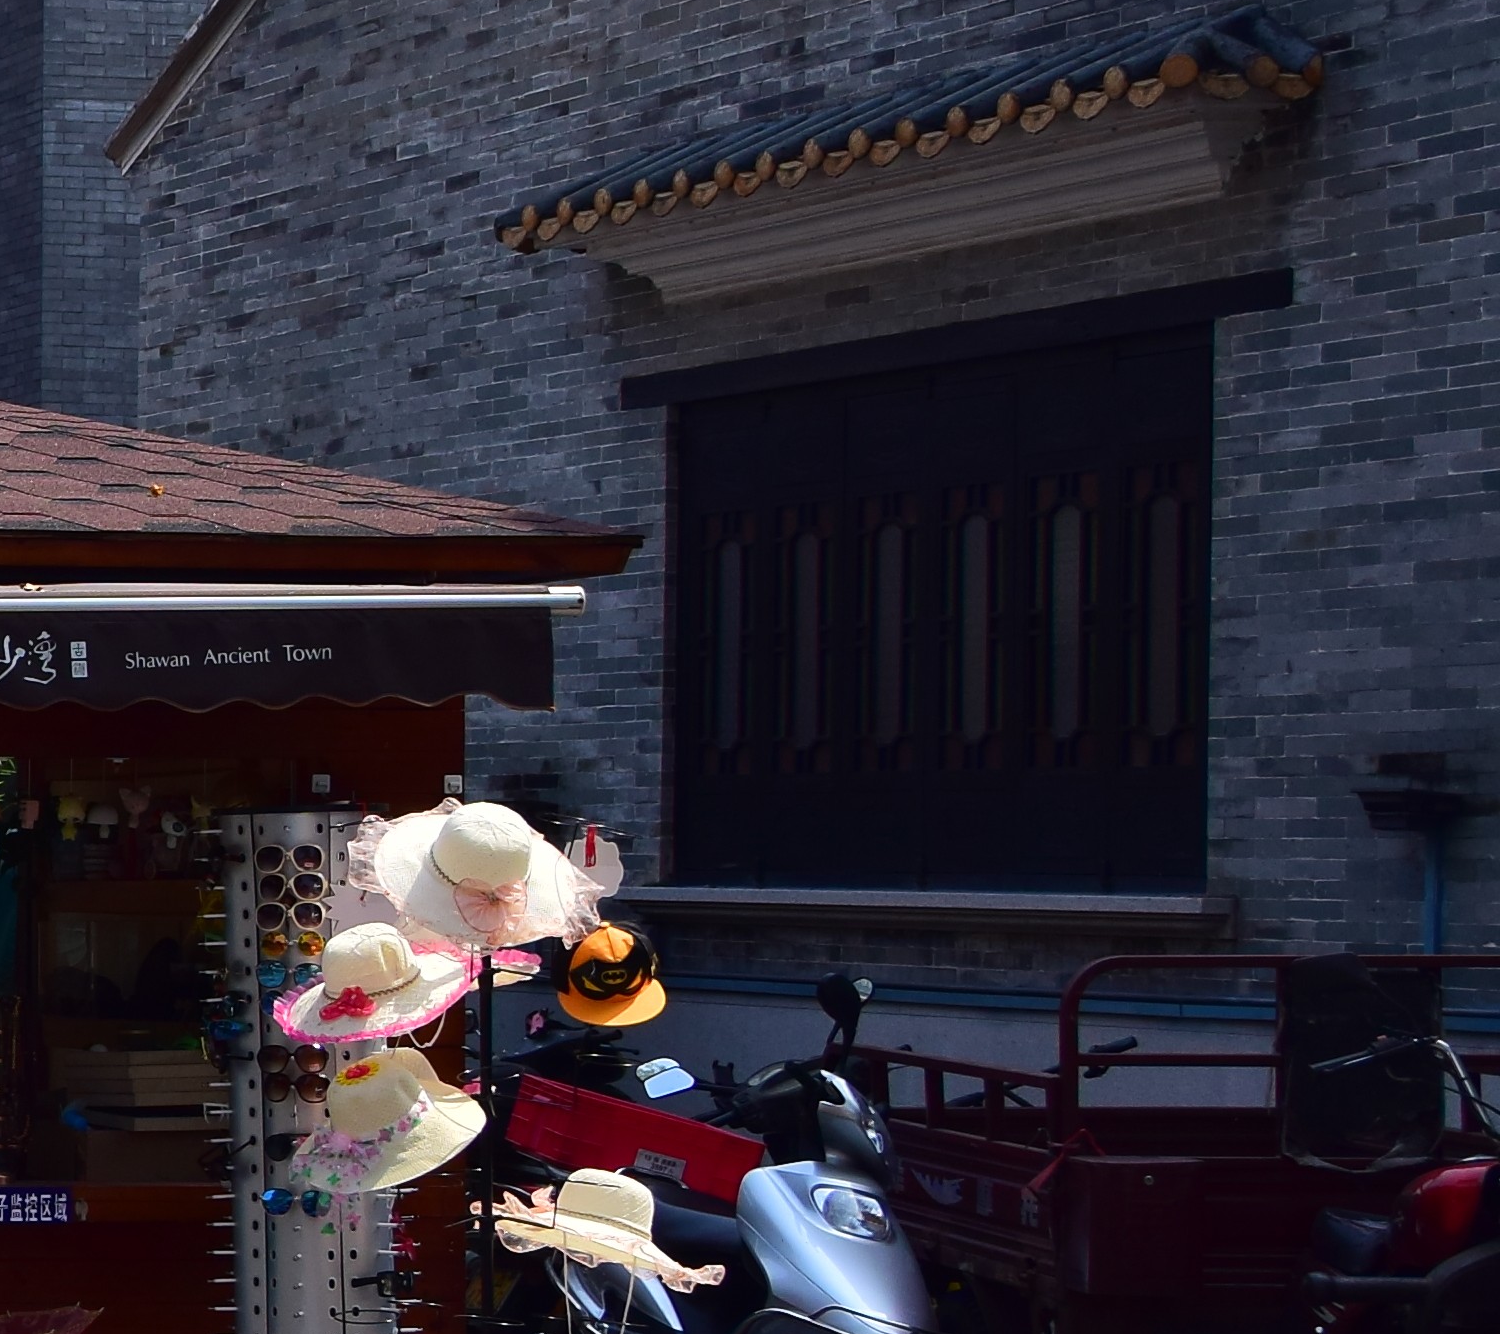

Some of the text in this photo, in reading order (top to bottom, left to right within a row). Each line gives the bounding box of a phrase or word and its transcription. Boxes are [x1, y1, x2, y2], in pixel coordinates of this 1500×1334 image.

[125, 643, 333, 669] Shawan Ancient Town
